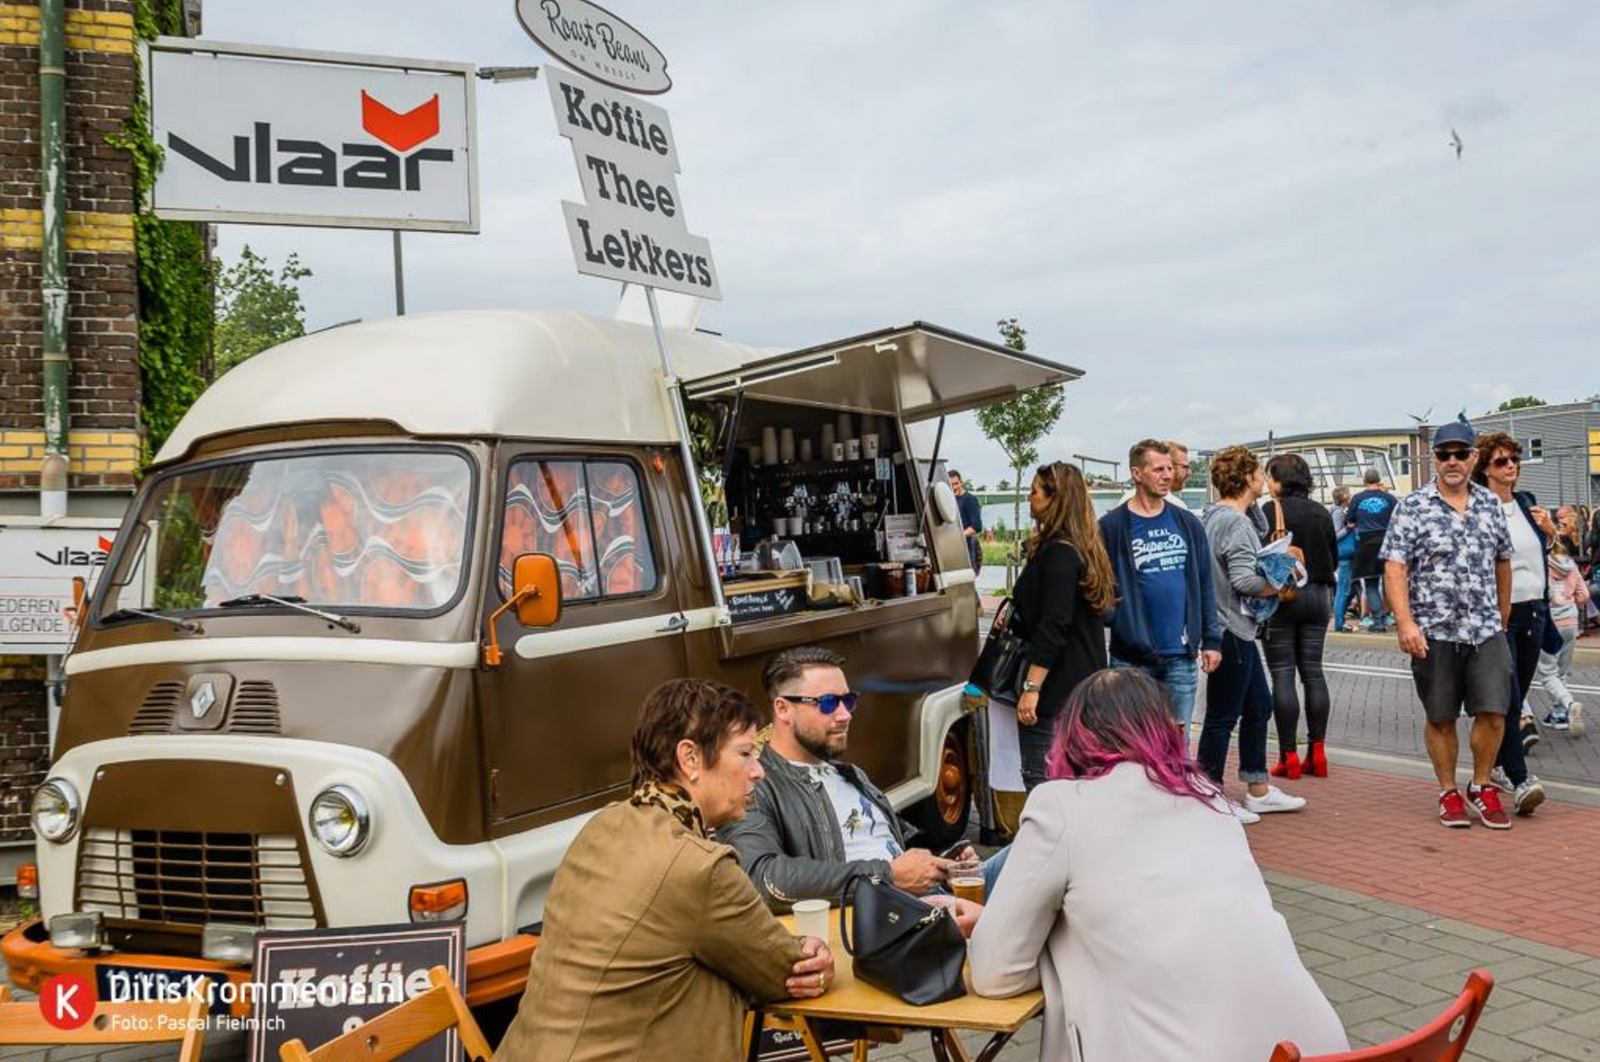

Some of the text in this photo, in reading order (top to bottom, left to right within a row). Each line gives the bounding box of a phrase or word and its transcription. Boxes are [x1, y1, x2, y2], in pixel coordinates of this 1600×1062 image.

[540, 0, 650, 73] Roast Beans
[560, 82, 669, 156] Koffie
[167, 121, 453, 192] vlaar
[586, 155, 676, 218] Thee
[578, 218, 712, 288] Lekkers
[1147, 528, 1171, 538] REAL
[278, 962, 434, 1010] Koffie
